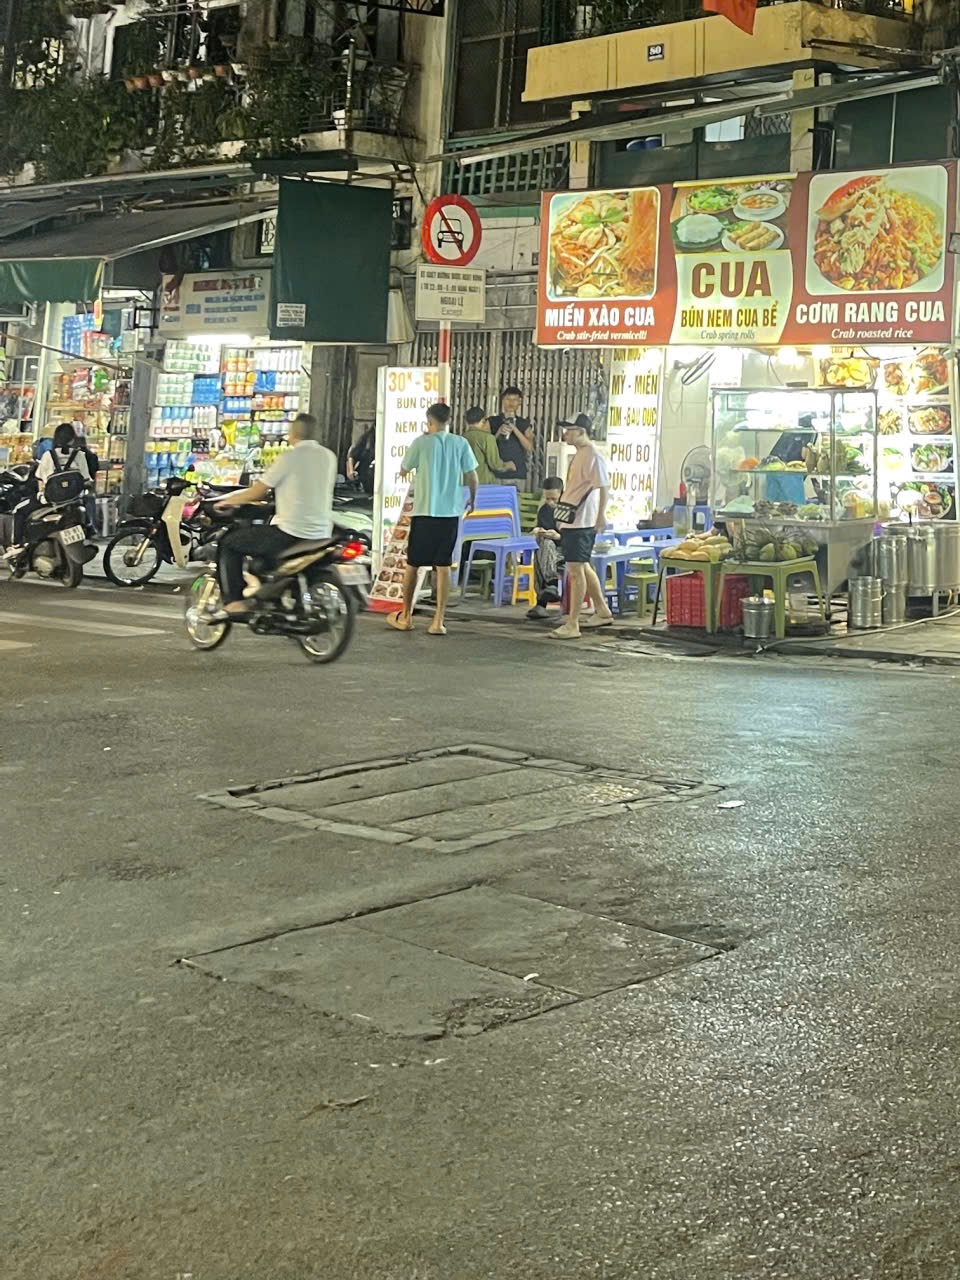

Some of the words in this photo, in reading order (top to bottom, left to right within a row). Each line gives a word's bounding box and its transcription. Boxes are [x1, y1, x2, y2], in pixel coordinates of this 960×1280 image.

[691, 260, 773, 299] CUA
[545, 303, 585, 327] MIẾN
[588, 303, 620, 326] XÀO
[624, 306, 655, 327] CUA
[681, 303, 703, 328] BÚN
[707, 308, 732, 328] NEM
[736, 308, 758, 327] CUA
[795, 301, 839, 324] CƠM
[845, 303, 898, 324] RANG
[905, 300, 945, 323] CUA
[557, 330, 575, 340] Crab
[576, 330, 609, 342] stir-fried
[611, 330, 648, 341] vermicelli
[700, 329, 718, 340] Crab
[718, 330, 739, 342] spring
[740, 329, 755, 340] rolls
[831, 327, 855, 339] Crab
[857, 327, 892, 339] roasted
[893, 327, 913, 338] rice
